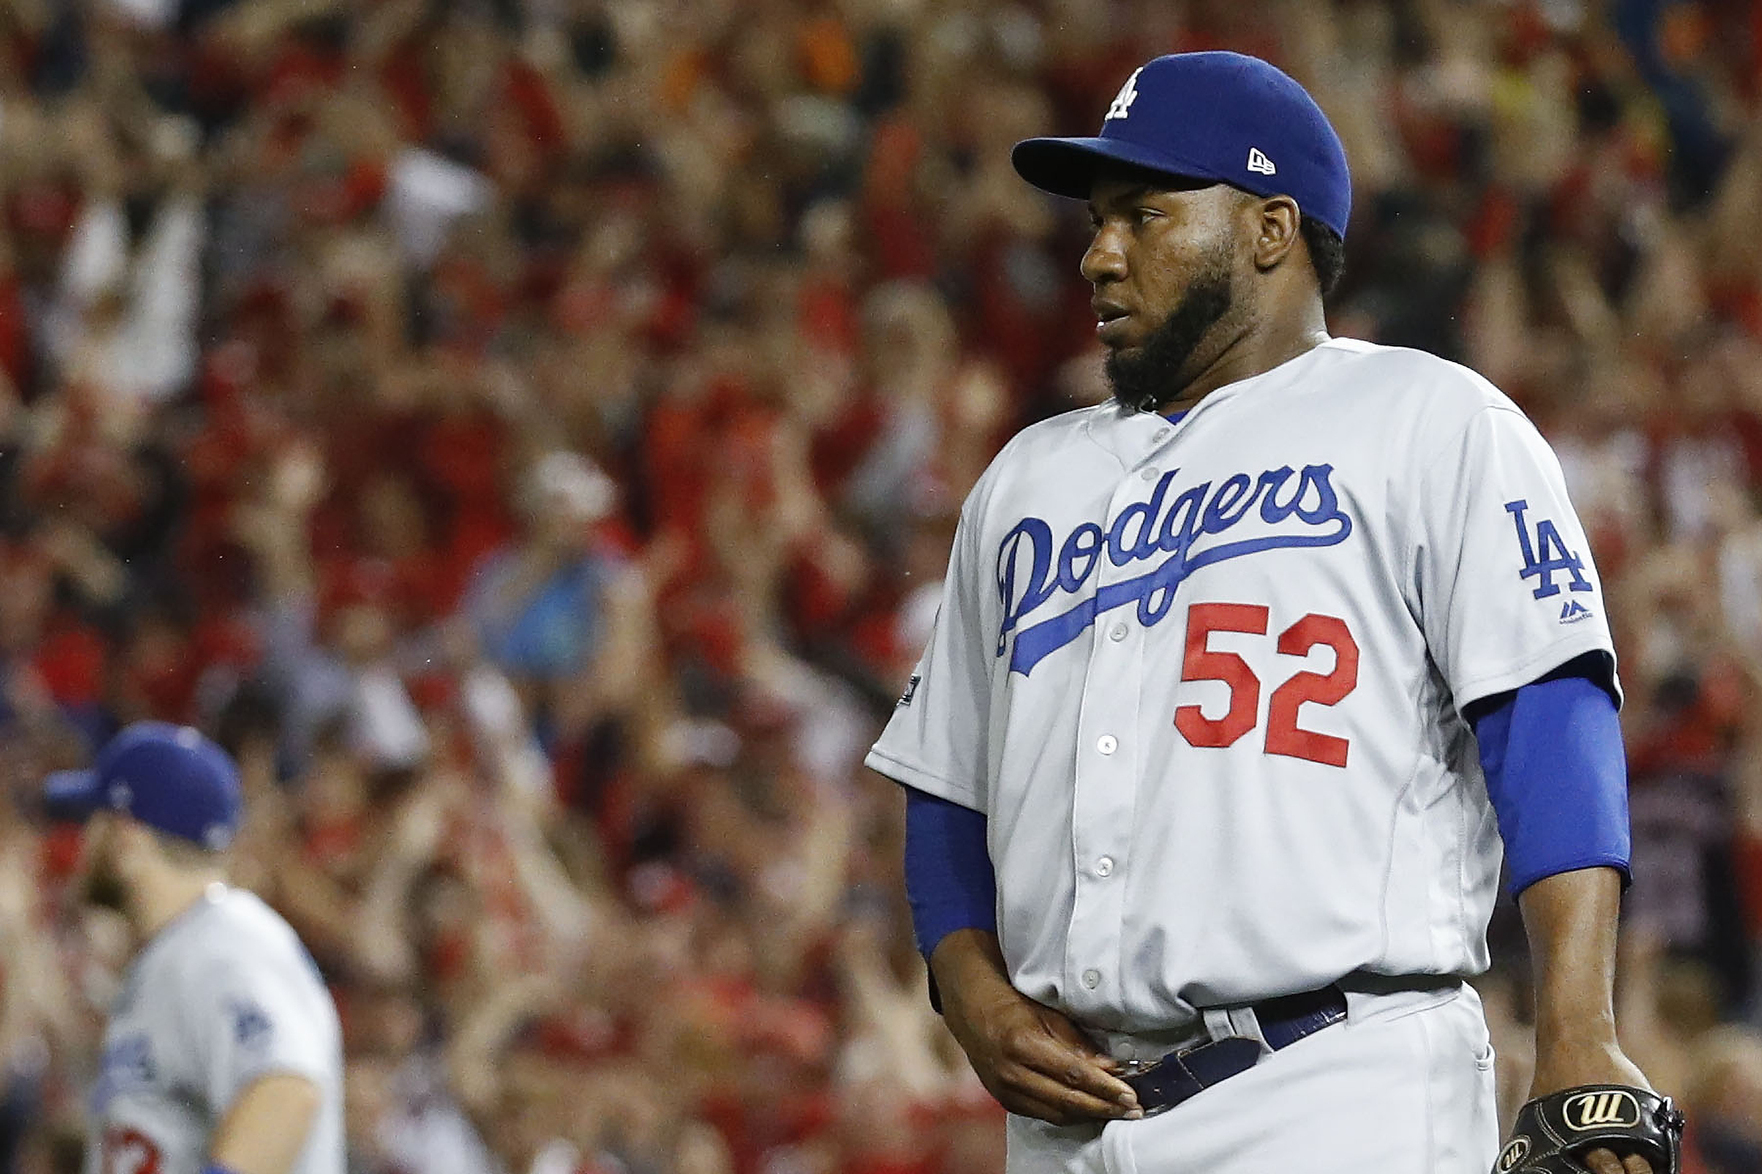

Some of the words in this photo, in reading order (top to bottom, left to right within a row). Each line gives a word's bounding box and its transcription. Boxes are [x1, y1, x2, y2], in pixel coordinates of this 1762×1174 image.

[997, 463, 1352, 677] Dodgers
[1504, 499, 1593, 600] LA
[1173, 602, 1360, 769] 52
